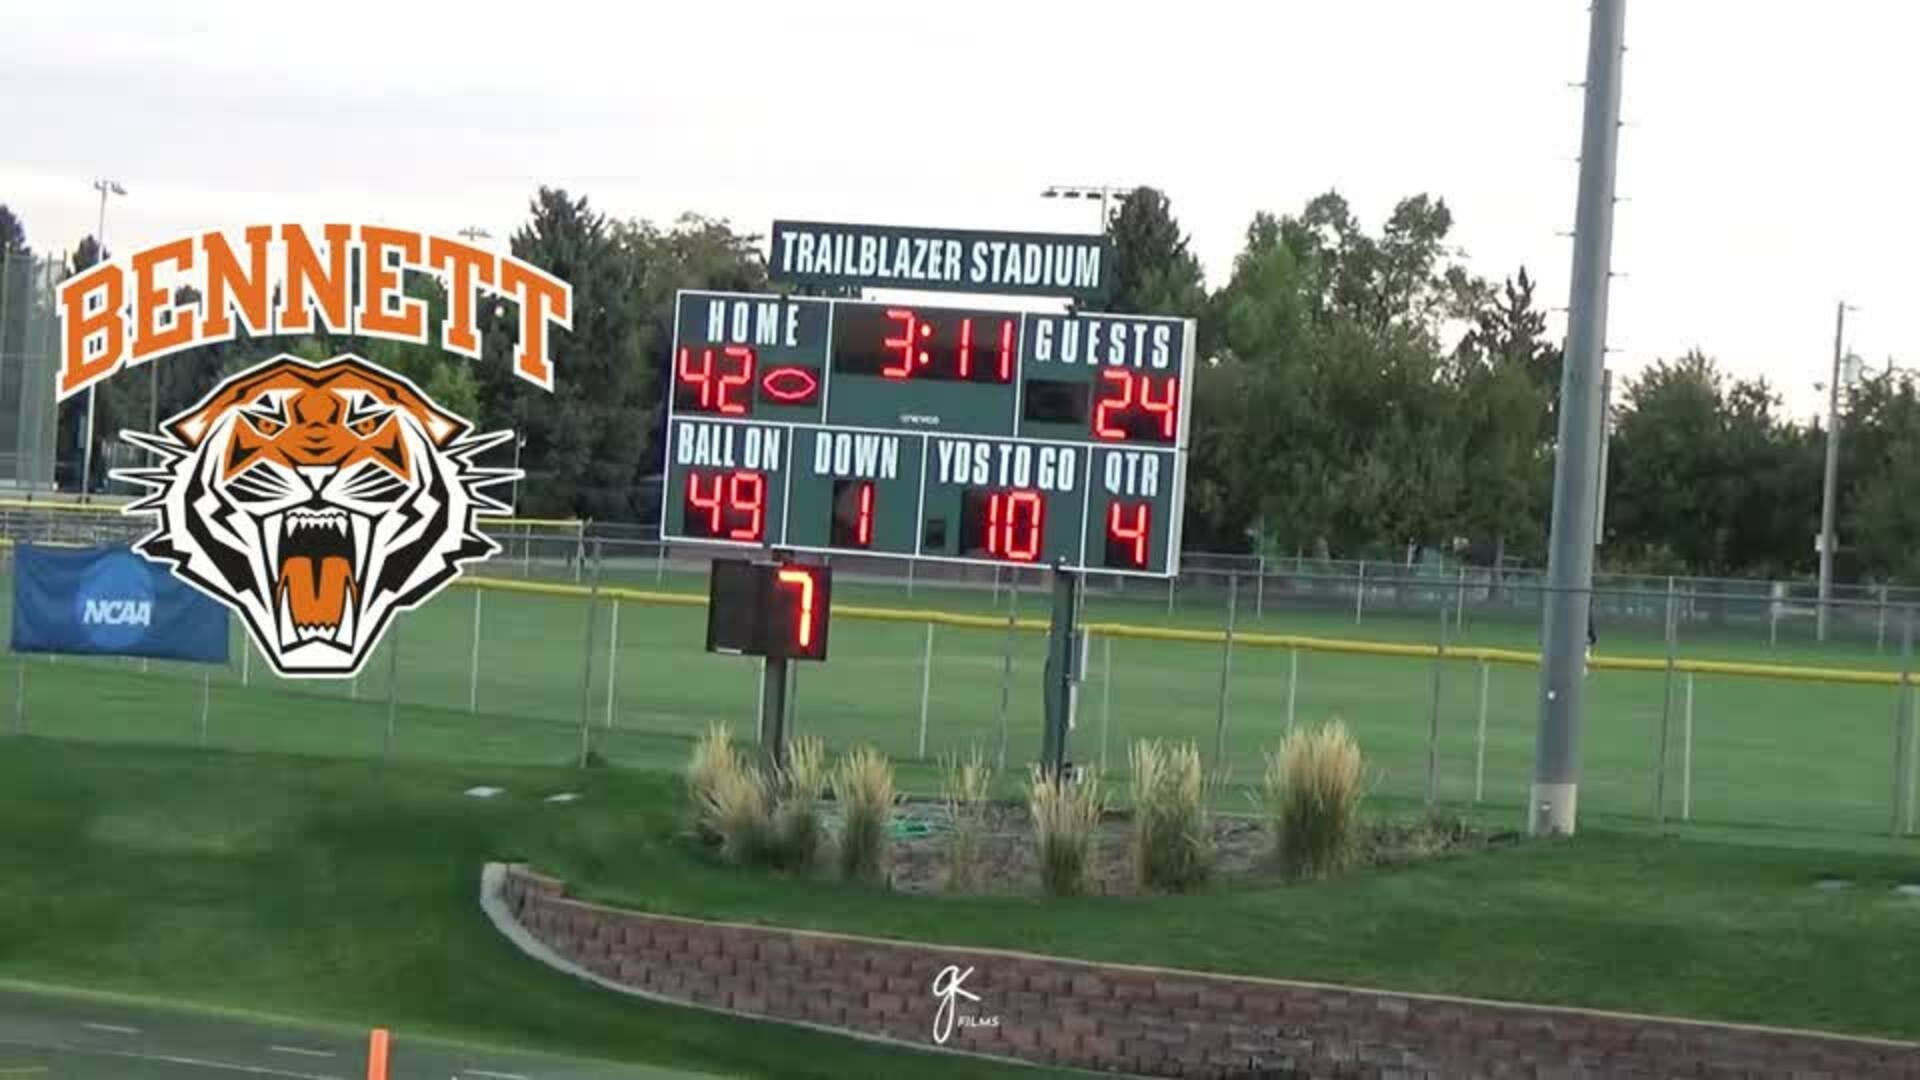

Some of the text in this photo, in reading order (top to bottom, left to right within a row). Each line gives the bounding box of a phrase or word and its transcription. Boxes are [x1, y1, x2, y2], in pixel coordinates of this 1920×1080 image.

[781, 231, 1101, 288] TRAILBLAZER STADIUM
[708, 301, 799, 346] HOME
[882, 309, 1015, 382] 3:11
[1035, 319, 1170, 366] GUESTS
[678, 346, 752, 414] 42
[1095, 369, 1176, 440] 24
[677, 423, 781, 472] BALL ON
[813, 432, 899, 480] DOWN
[937, 440, 1076, 492] YDS TO GO
[1104, 451, 1159, 496] QTR
[688, 472, 764, 540] 49
[856, 483, 873, 545] 1
[986, 491, 1041, 561] 10
[1109, 502, 1146, 564] 4
[83, 600, 151, 626] NCAA
[777, 569, 814, 648] 7
